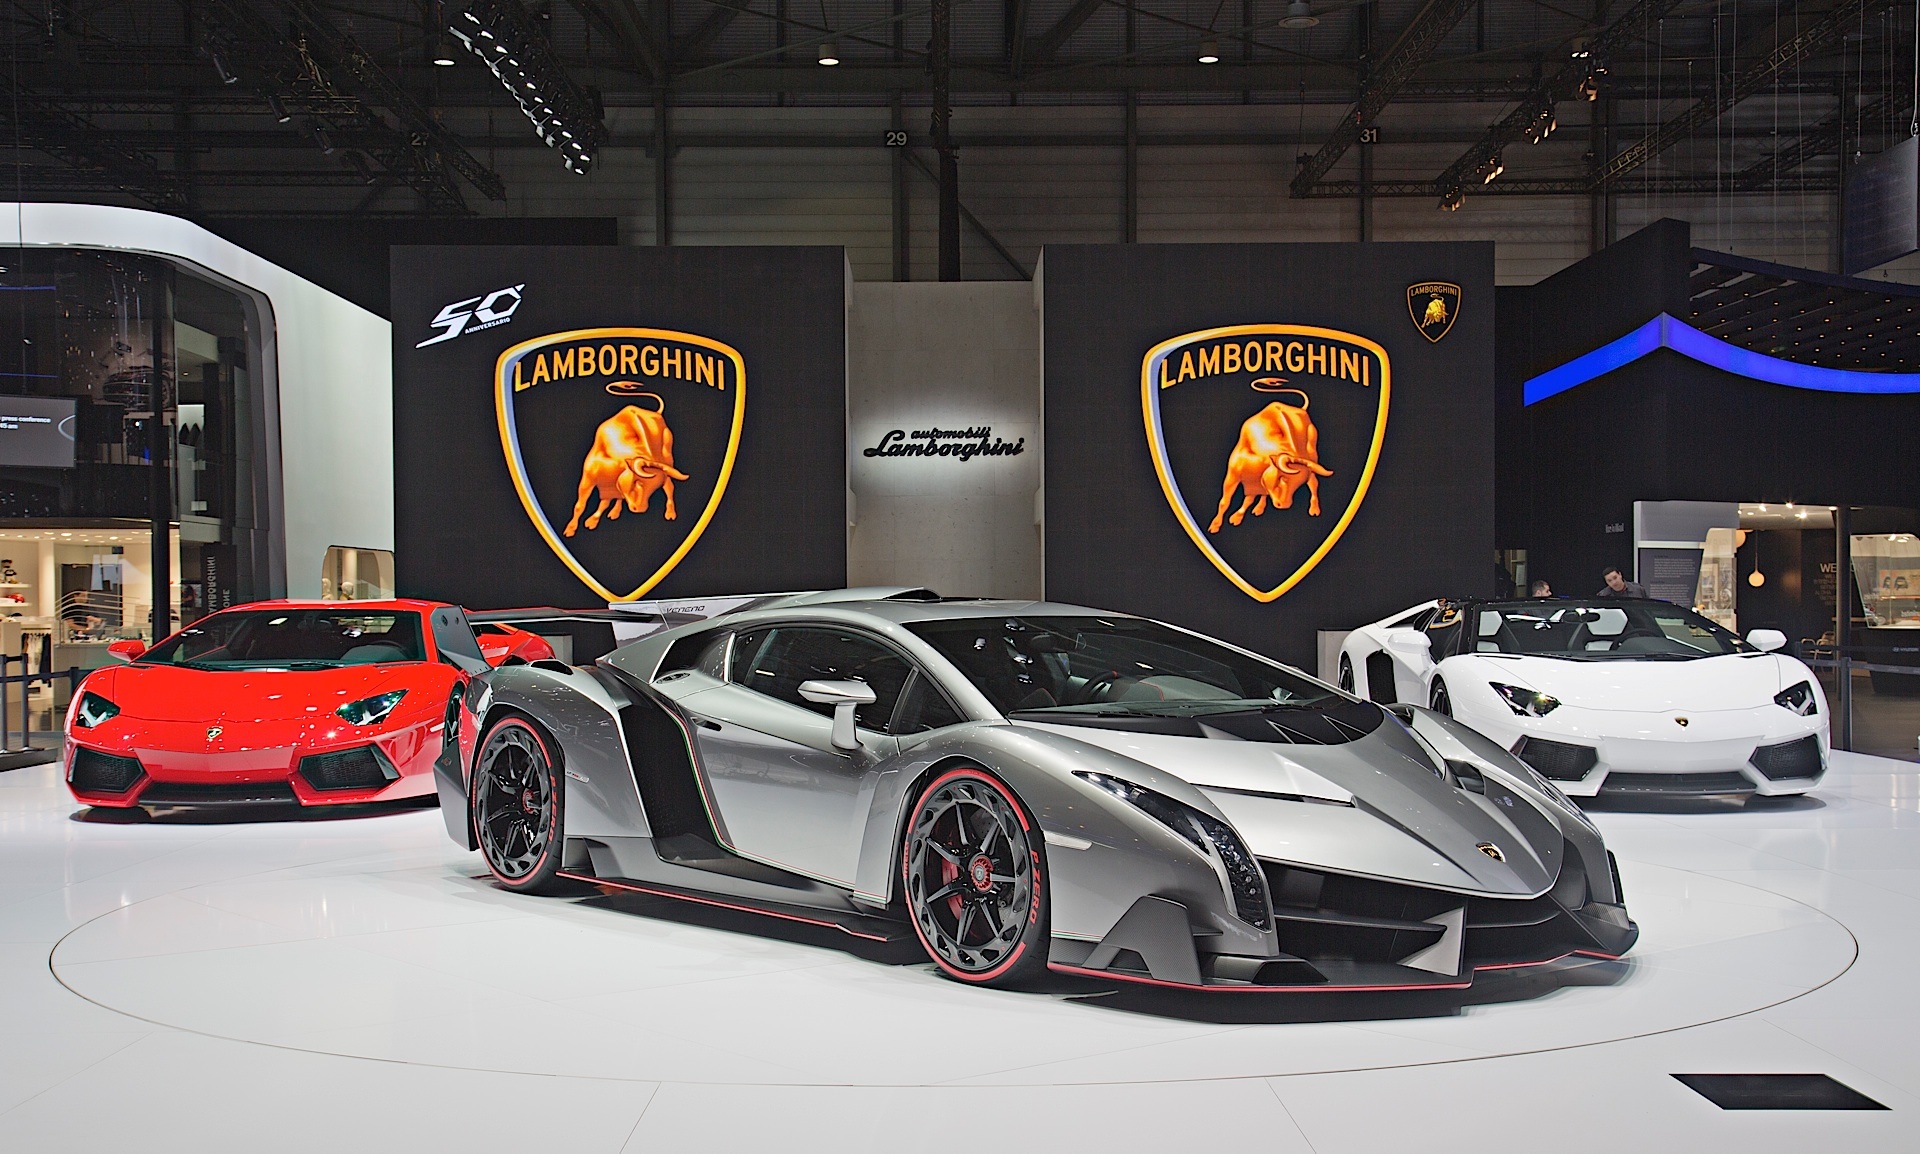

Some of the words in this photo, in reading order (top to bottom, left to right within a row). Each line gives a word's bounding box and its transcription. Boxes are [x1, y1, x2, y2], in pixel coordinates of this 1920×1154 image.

[887, 131, 907, 145] 29
[1360, 128, 1376, 142] 31
[1411, 286, 1457, 296] LAMBORGHINI
[464, 317, 511, 335] ANNIVERSARIO
[514, 345, 725, 392] LAMBORGHINI
[1160, 341, 1370, 389] LAMBORGHINI
[911, 427, 991, 439] automobili
[863, 430, 1025, 462] Lamborghini
[1030, 850, 1039, 864] P
[1029, 867, 1041, 925] ZERO
